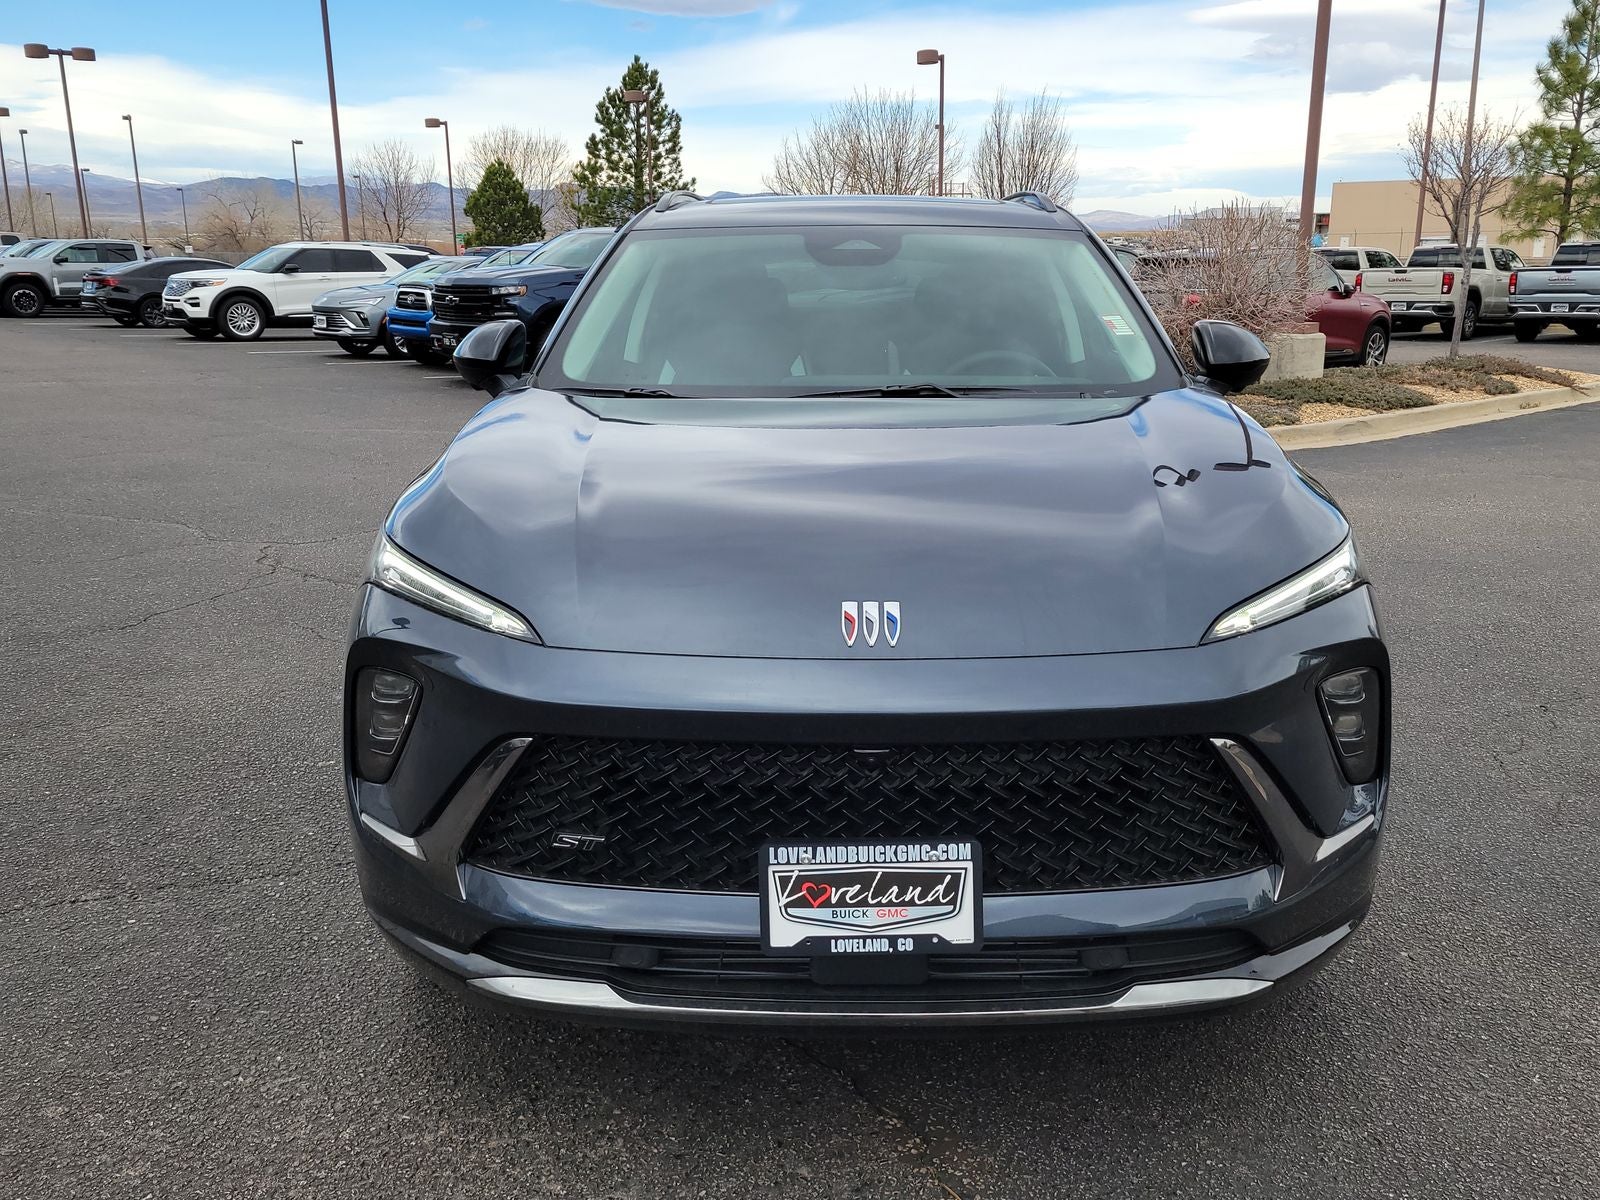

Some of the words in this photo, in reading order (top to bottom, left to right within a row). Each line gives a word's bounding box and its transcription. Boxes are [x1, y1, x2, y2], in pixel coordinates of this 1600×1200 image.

[768, 842, 972, 865] LOVELANDBUICKGMCCOM
[831, 909, 869, 919] BUICK
[876, 908, 909, 918] GMC
[830, 938, 894, 953] LOVELAND,
[897, 937, 914, 952] CO
